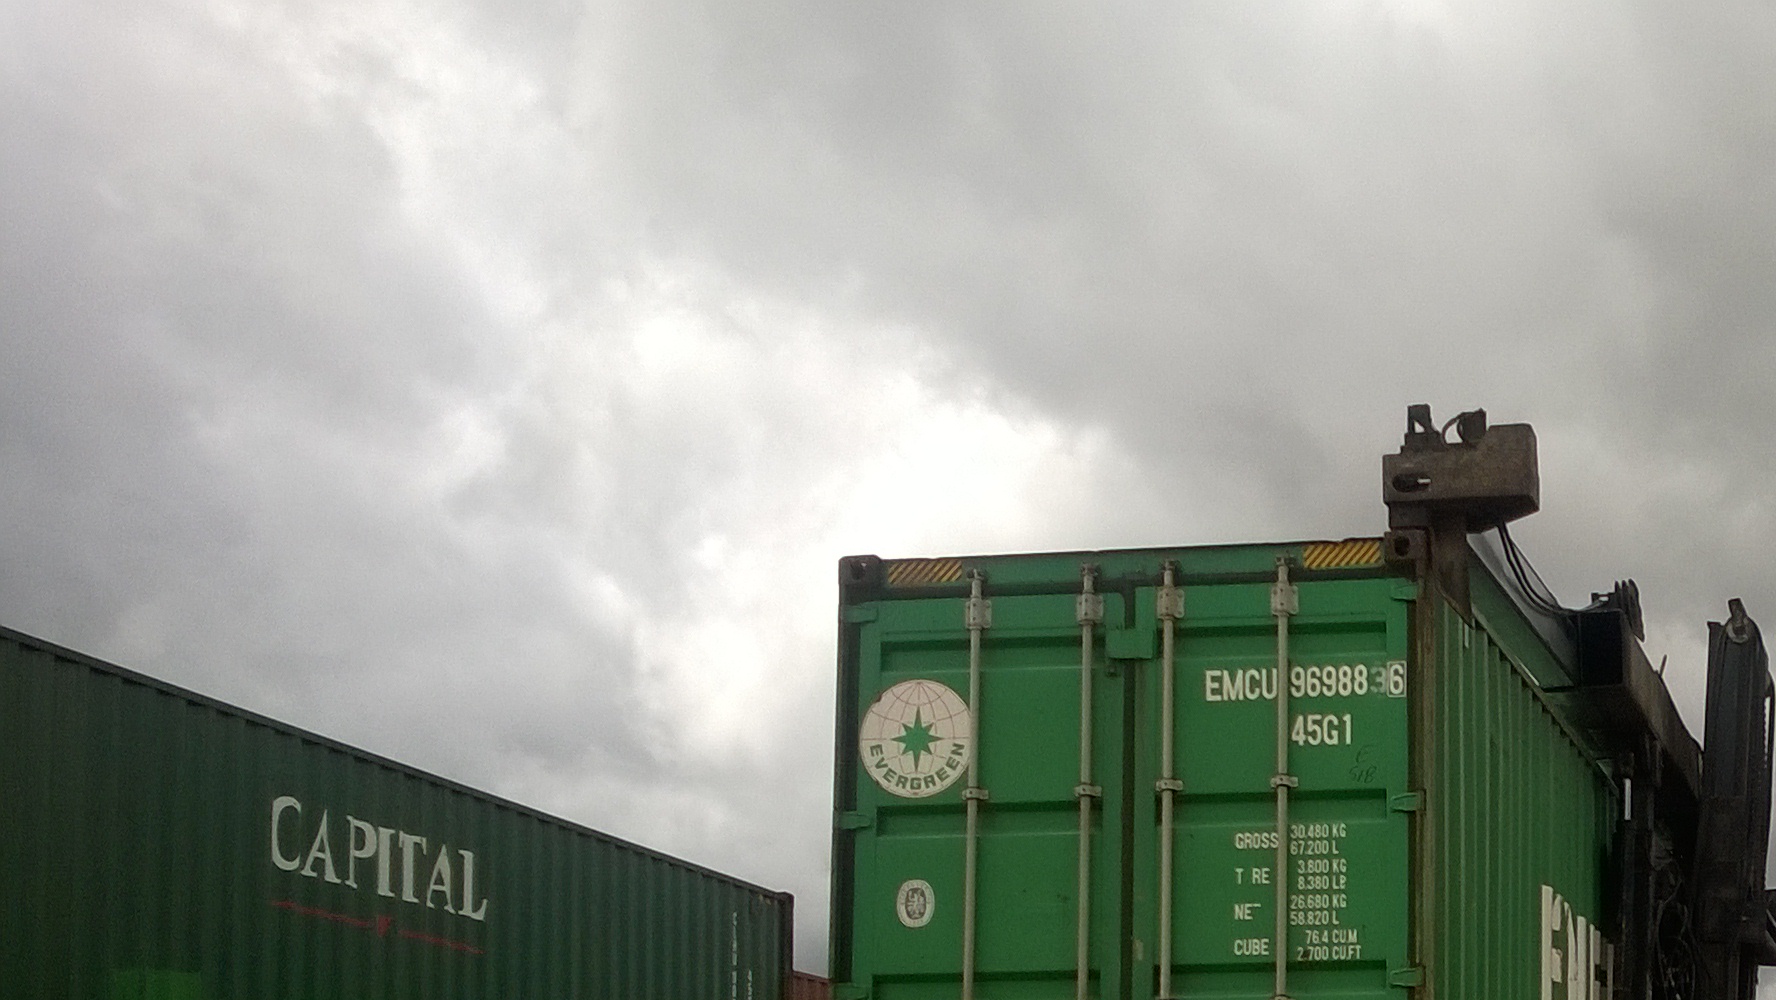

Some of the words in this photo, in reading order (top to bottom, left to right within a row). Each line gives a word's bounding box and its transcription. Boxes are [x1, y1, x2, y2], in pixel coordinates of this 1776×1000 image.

[1205, 668, 1278, 701] EMCU
[1291, 714, 1352, 745] 45G1
[869, 743, 965, 790] EVERGREEN
[1332, 823, 1347, 838] KG
[1234, 832, 1279, 849] GROSS
[271, 795, 488, 921] CAPITAL
[1332, 859, 1347, 873] KG
[1235, 867, 1271, 885] TRE
[1332, 893, 1347, 908] KG
[1234, 938, 1270, 956] CUBE
